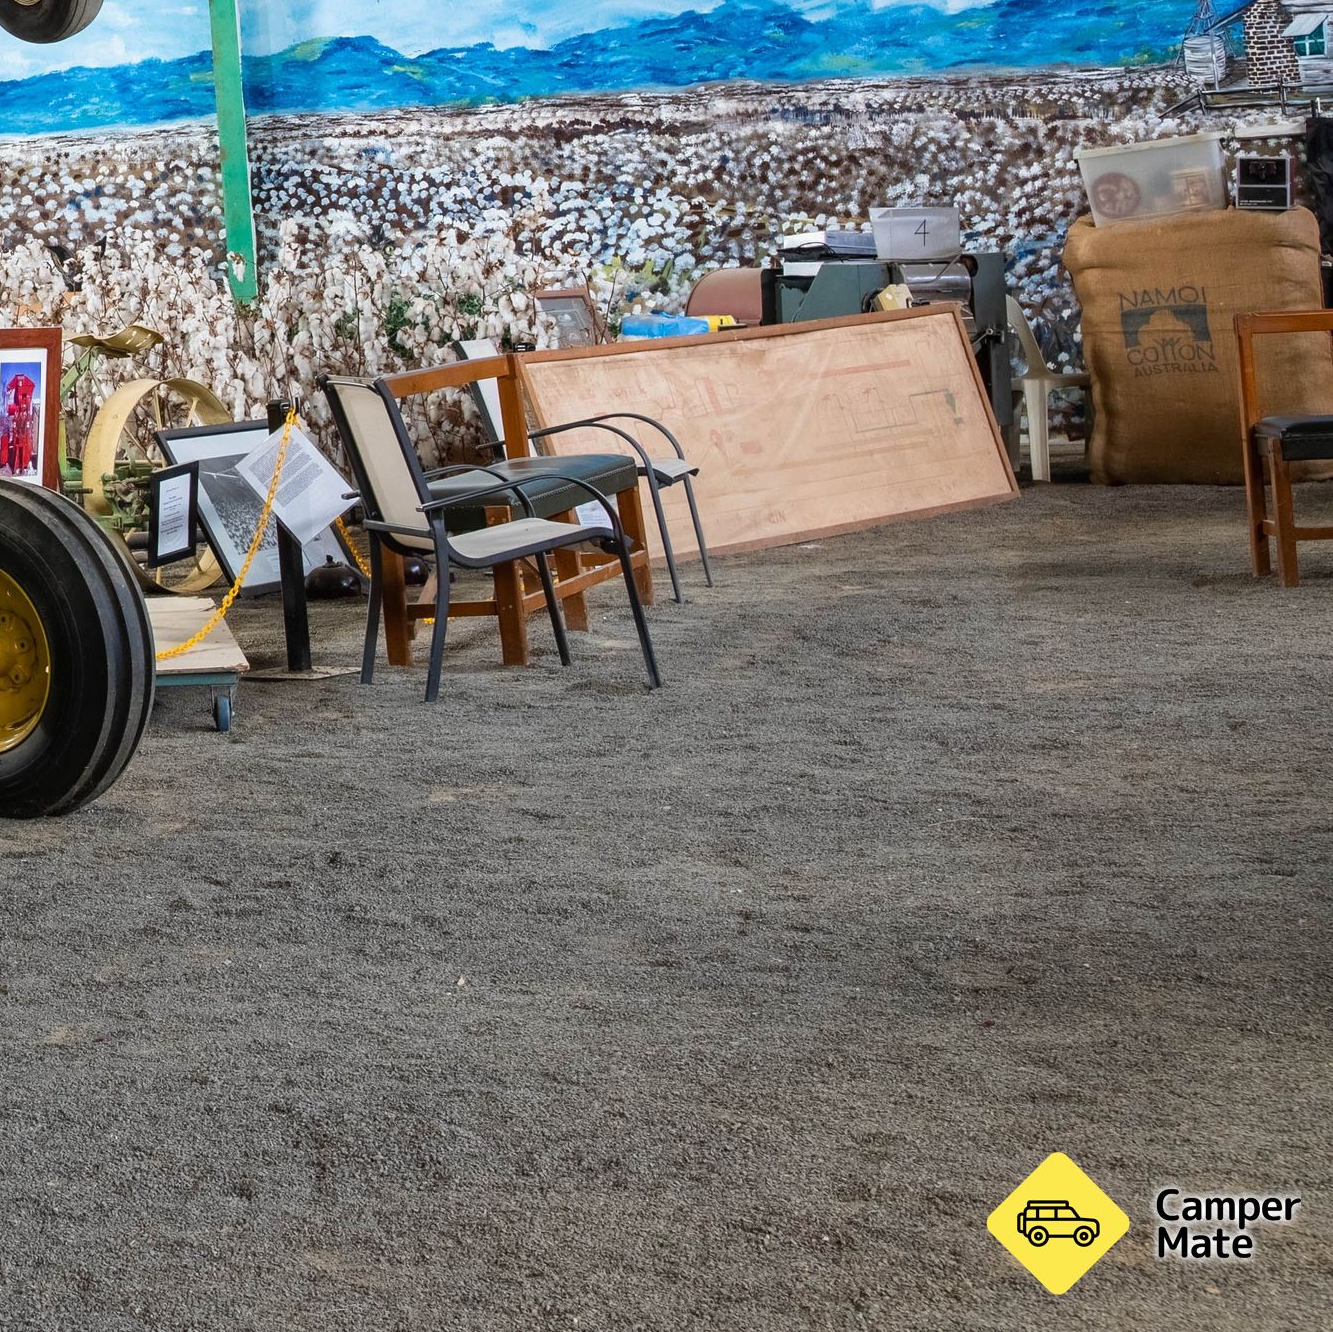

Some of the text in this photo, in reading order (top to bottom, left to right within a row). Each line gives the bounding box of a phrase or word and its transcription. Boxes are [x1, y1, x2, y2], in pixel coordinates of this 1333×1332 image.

[914, 219, 930, 247] 4
[1117, 286, 1207, 311] NAMOI
[1126, 342, 1216, 366] COTTON
[1134, 362, 1220, 379] AUSTRALIA
